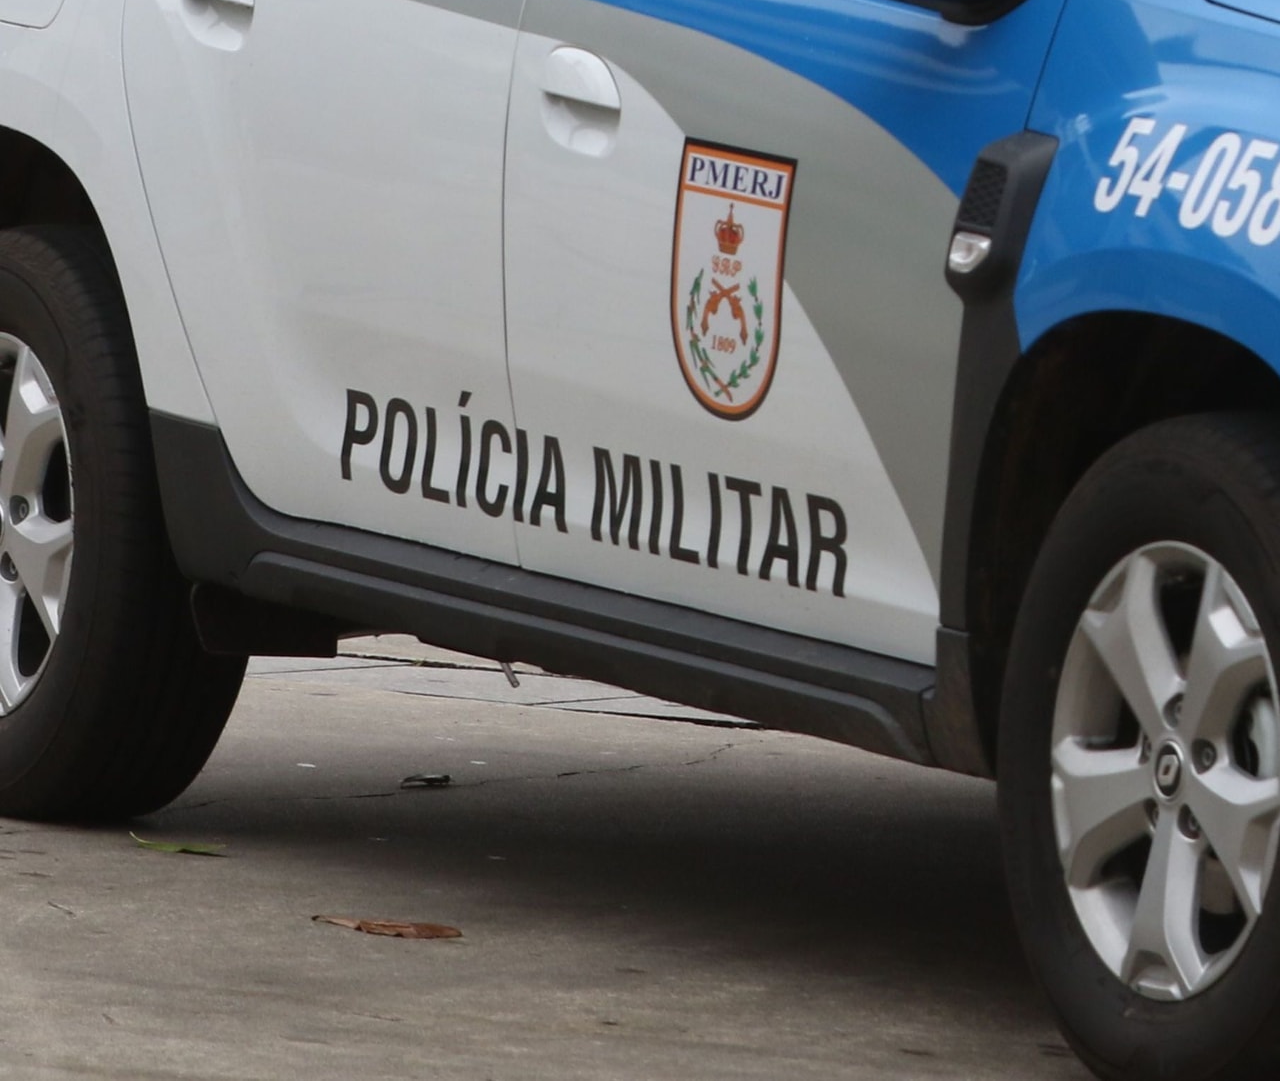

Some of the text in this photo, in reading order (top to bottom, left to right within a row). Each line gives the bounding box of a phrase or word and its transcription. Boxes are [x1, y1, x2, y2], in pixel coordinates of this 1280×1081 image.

[688, 156, 786, 200] PMERJ
[711, 334, 737, 354] 1809
[341, 389, 848, 598] POLÍCIA MILITAR
